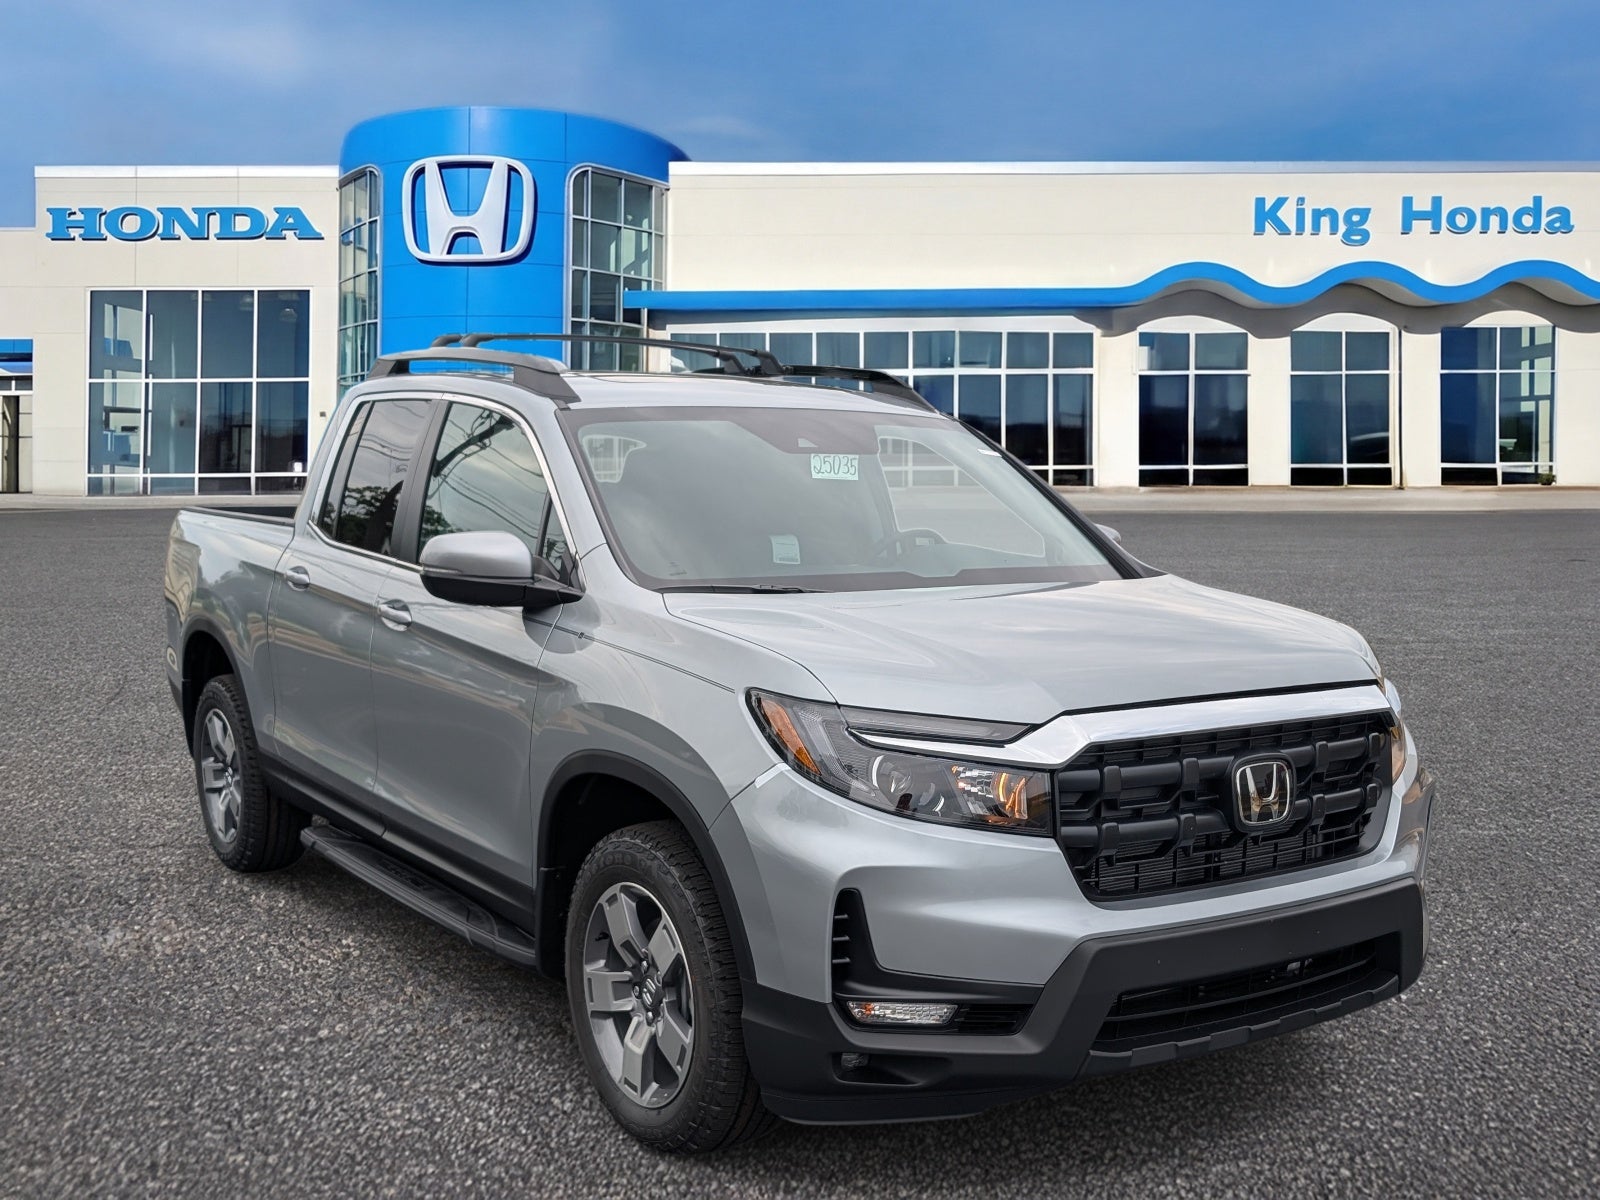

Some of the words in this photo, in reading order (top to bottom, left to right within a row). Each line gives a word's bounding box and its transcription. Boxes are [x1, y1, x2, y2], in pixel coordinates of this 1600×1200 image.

[45, 206, 325, 241] HONDA
[1253, 195, 1372, 246] King
[1400, 195, 1575, 234] Honda
[812, 454, 858, 476] 25035
